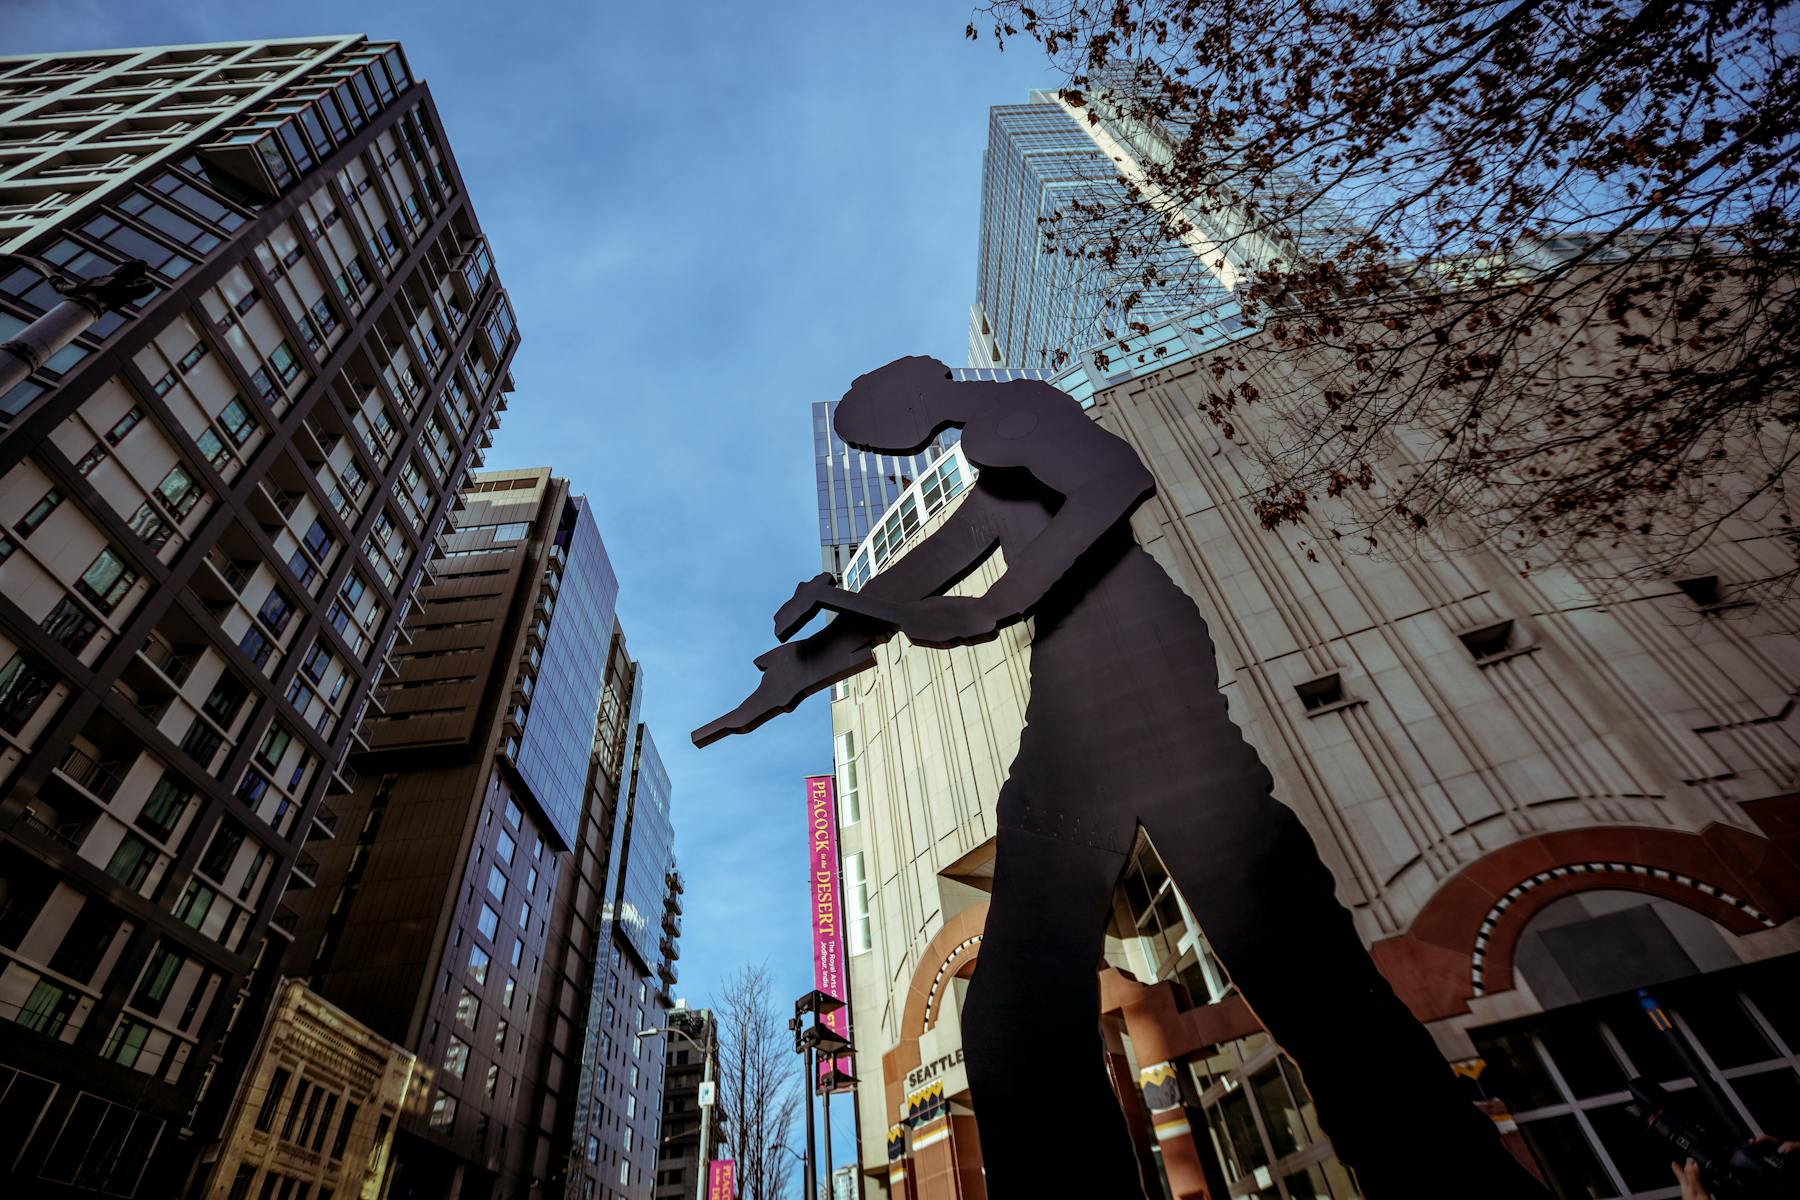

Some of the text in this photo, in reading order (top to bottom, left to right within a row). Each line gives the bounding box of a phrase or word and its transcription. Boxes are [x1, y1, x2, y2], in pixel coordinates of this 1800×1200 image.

[813, 781, 829, 852] PEACOCK
[817, 871, 834, 936] DESERT
[831, 989, 838, 998] of
[909, 1049, 964, 1088] SEATTLE
